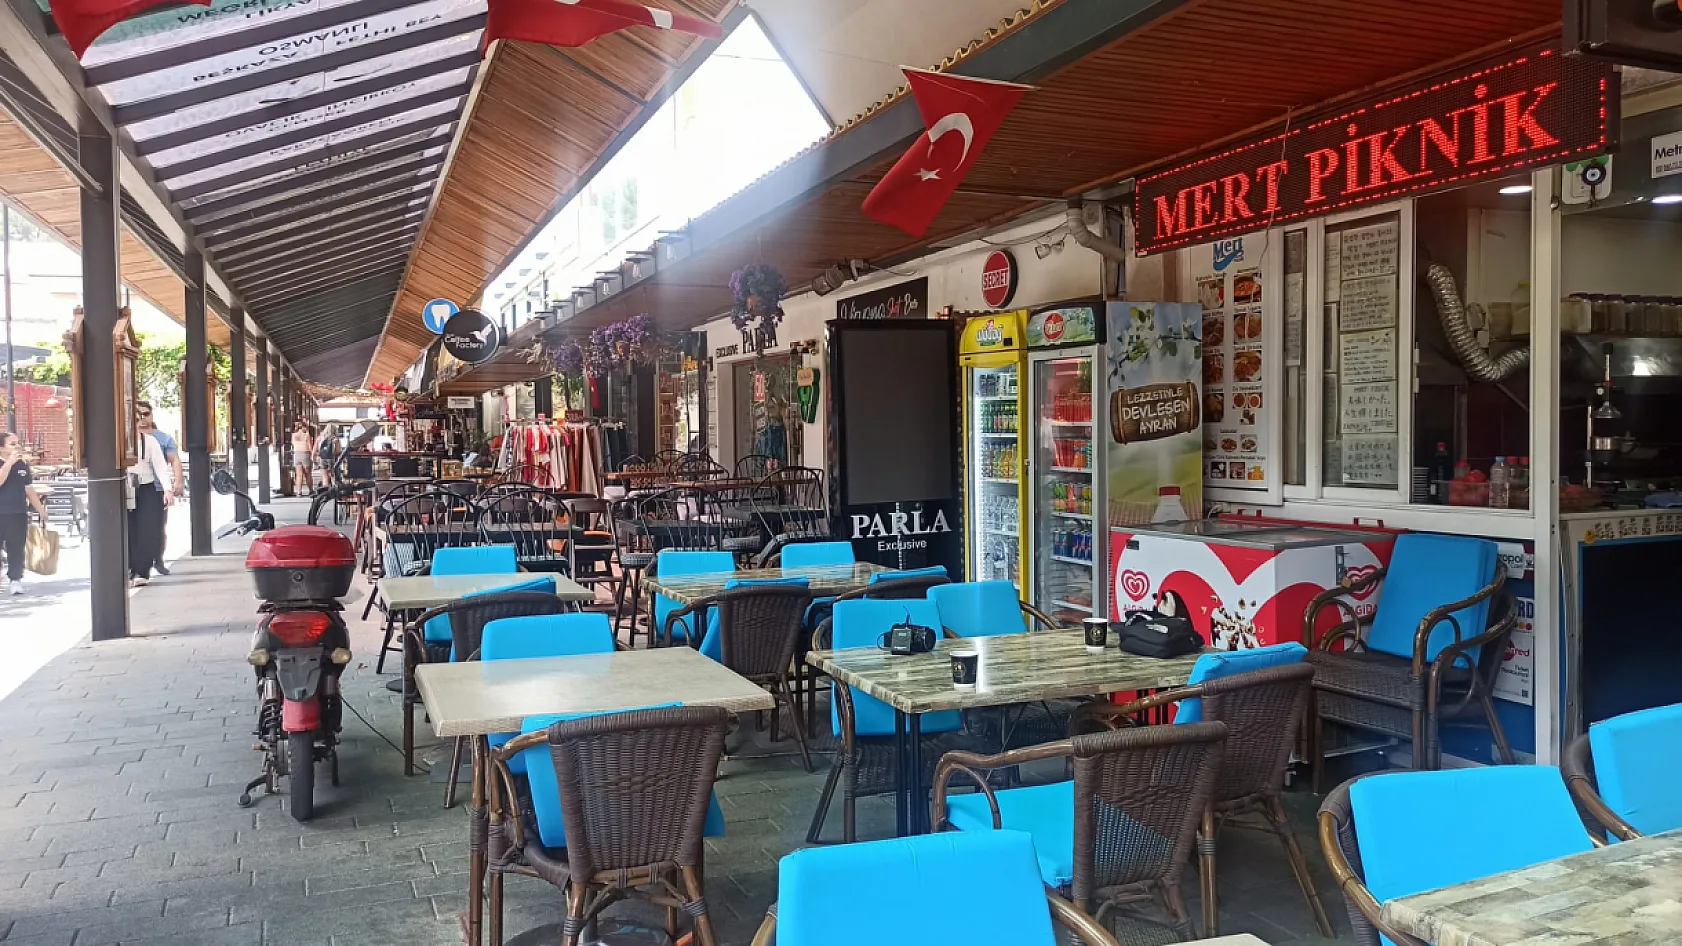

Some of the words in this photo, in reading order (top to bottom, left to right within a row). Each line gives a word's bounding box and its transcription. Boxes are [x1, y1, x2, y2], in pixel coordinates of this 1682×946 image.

[1153, 161, 1289, 241] MERT
[1304, 82, 1560, 204] PİKNİK
[983, 269, 1009, 287] SECRET
[742, 320, 778, 354] PALA
[716, 344, 739, 358] EXCLUSIVE
[1122, 396, 1191, 421] DEVLEŞEN
[1139, 416, 1177, 434] AYRAN
[850, 508, 952, 539] PARLA
[877, 539, 927, 551] Exclusive
